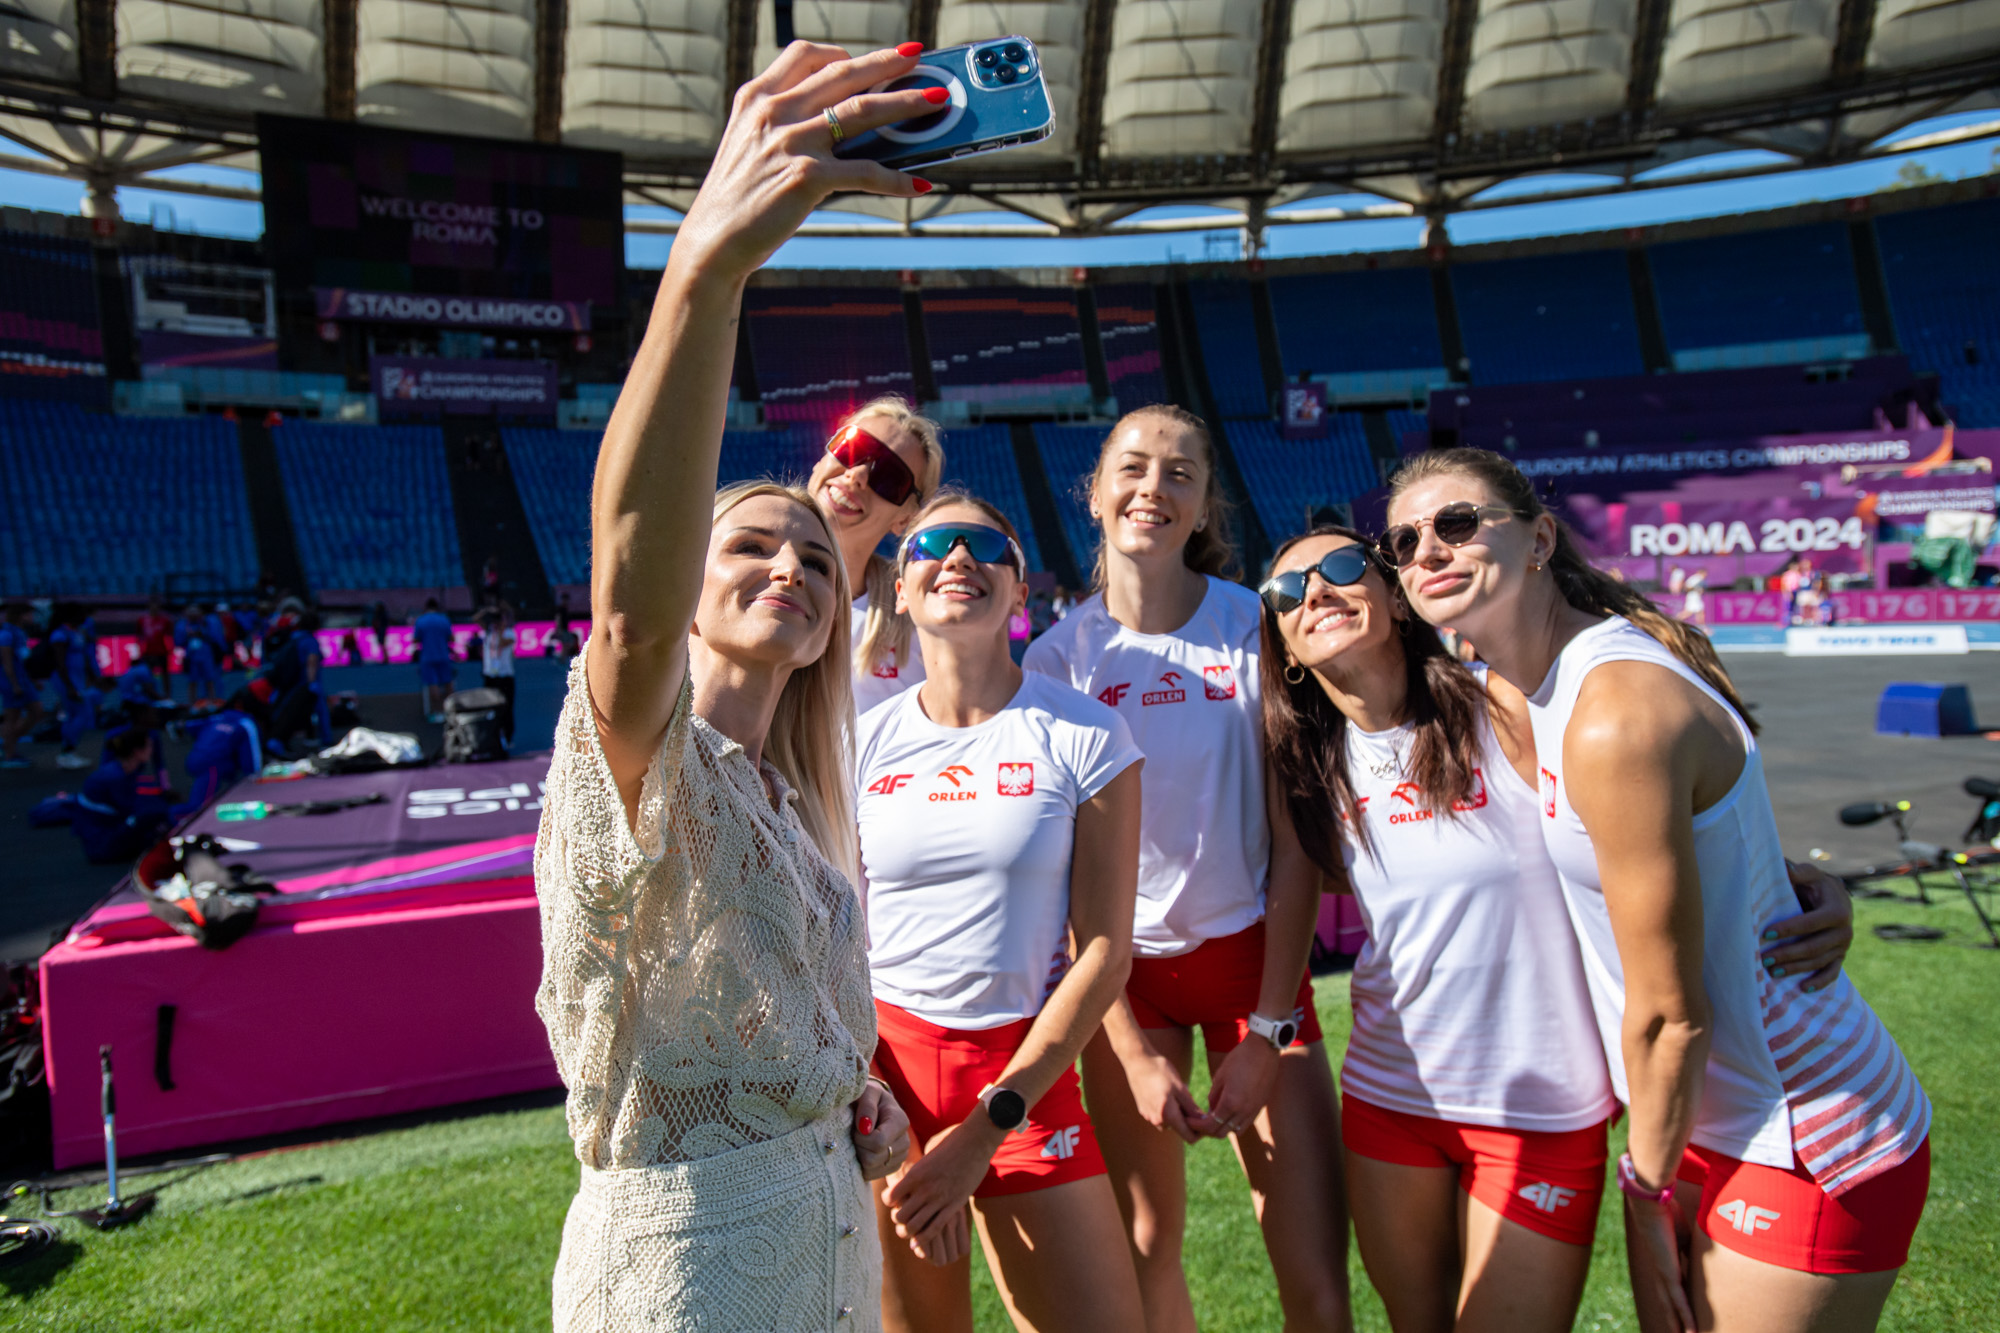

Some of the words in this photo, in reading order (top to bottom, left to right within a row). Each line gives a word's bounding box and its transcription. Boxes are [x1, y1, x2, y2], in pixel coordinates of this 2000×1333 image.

[360, 195, 501, 226] WELCOME
[507, 207, 544, 230] TO
[411, 220, 499, 246] ROMA
[346, 293, 442, 320] STADIO
[445, 299, 565, 327] OLIMPICO
[1515, 455, 1618, 478] EUROPEAN
[1620, 449, 1730, 473] ATHLETICS
[1731, 439, 1911, 468] CHAMPIONSHIPS
[1630, 521, 1757, 557] ROMA
[1760, 516, 1867, 551] 2024
[1719, 601, 1778, 619] 174
[1864, 597, 1928, 620] 176
[1097, 682, 1132, 707] 4F
[1143, 690, 1185, 705] ORLEN
[867, 773, 915, 795] 4F
[928, 791, 977, 802] ORLEN
[1389, 809, 1433, 825] ORLEN
[1040, 1125, 1081, 1160] 4F
[1518, 1181, 1577, 1213] 4F
[1716, 1199, 1781, 1236] 4F
